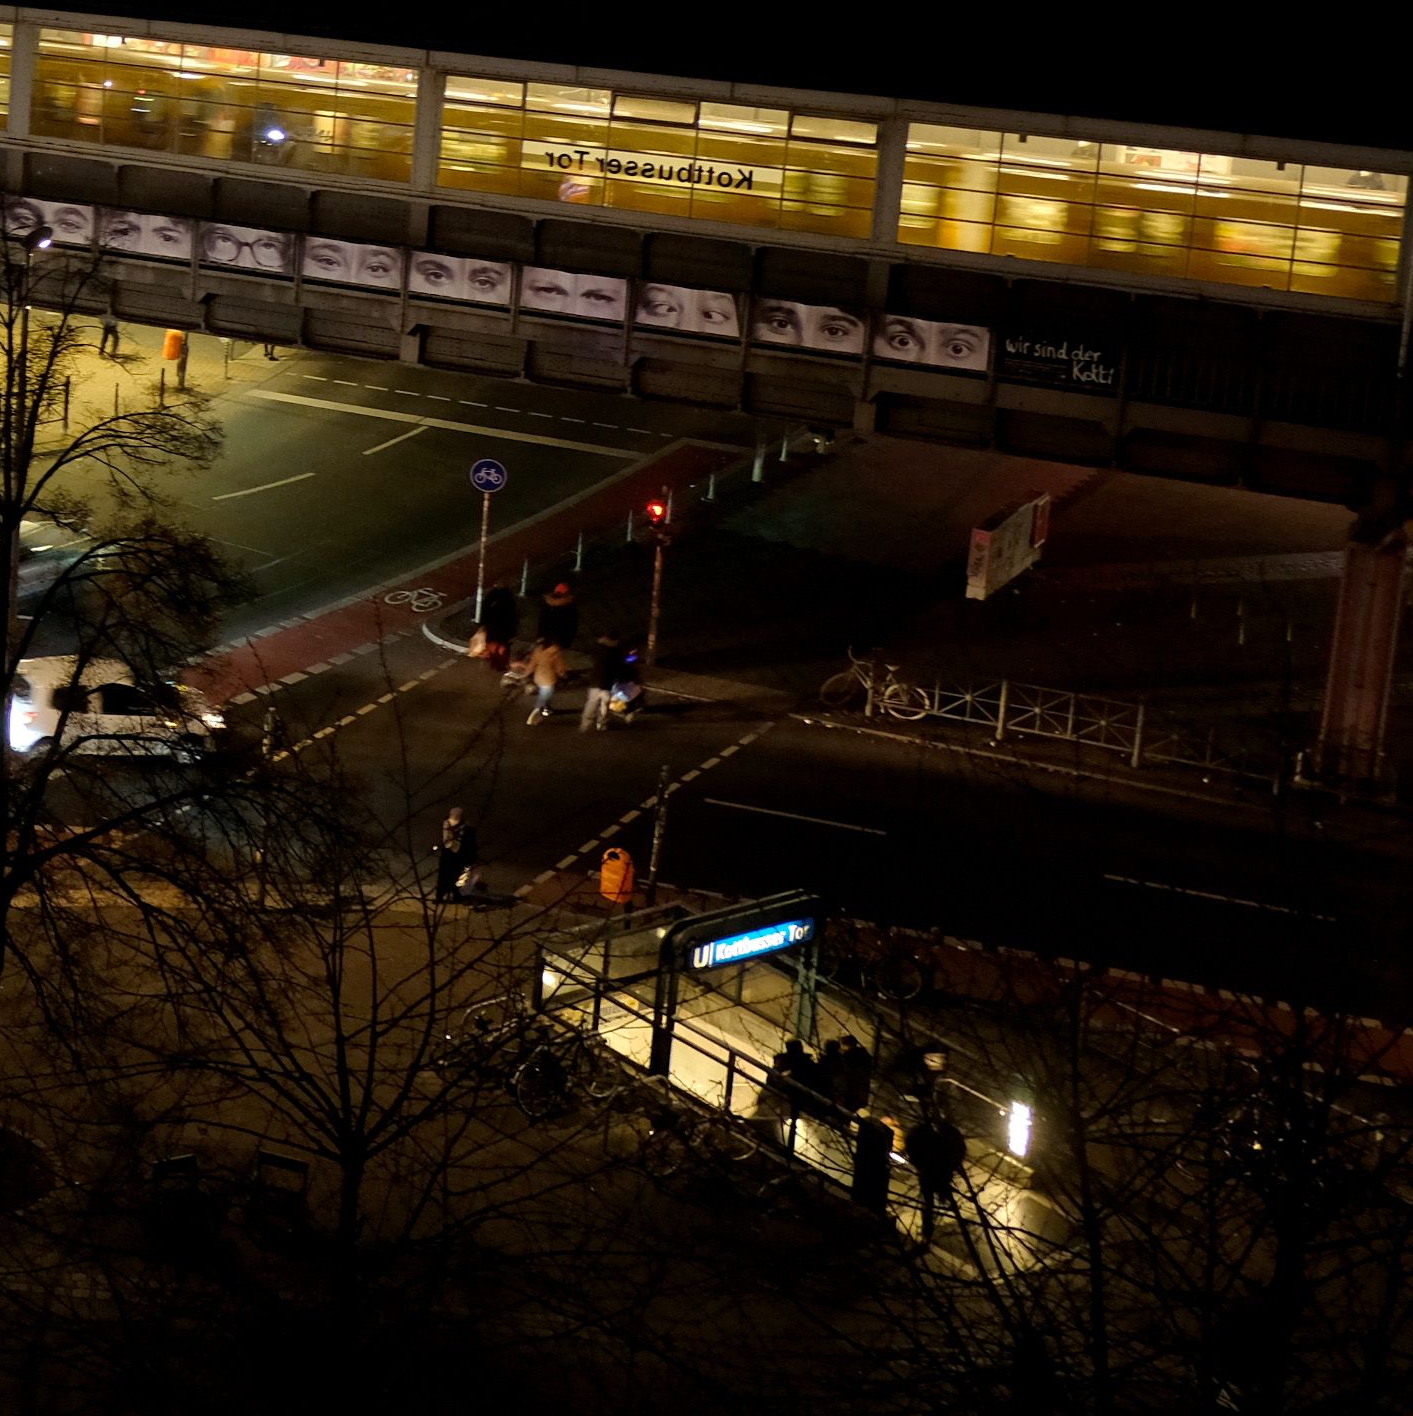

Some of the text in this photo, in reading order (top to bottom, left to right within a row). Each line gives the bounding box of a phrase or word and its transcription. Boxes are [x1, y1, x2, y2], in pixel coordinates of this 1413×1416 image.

[1005, 336, 1102, 362] wir sind der
[1072, 361, 1115, 384] Kotti
